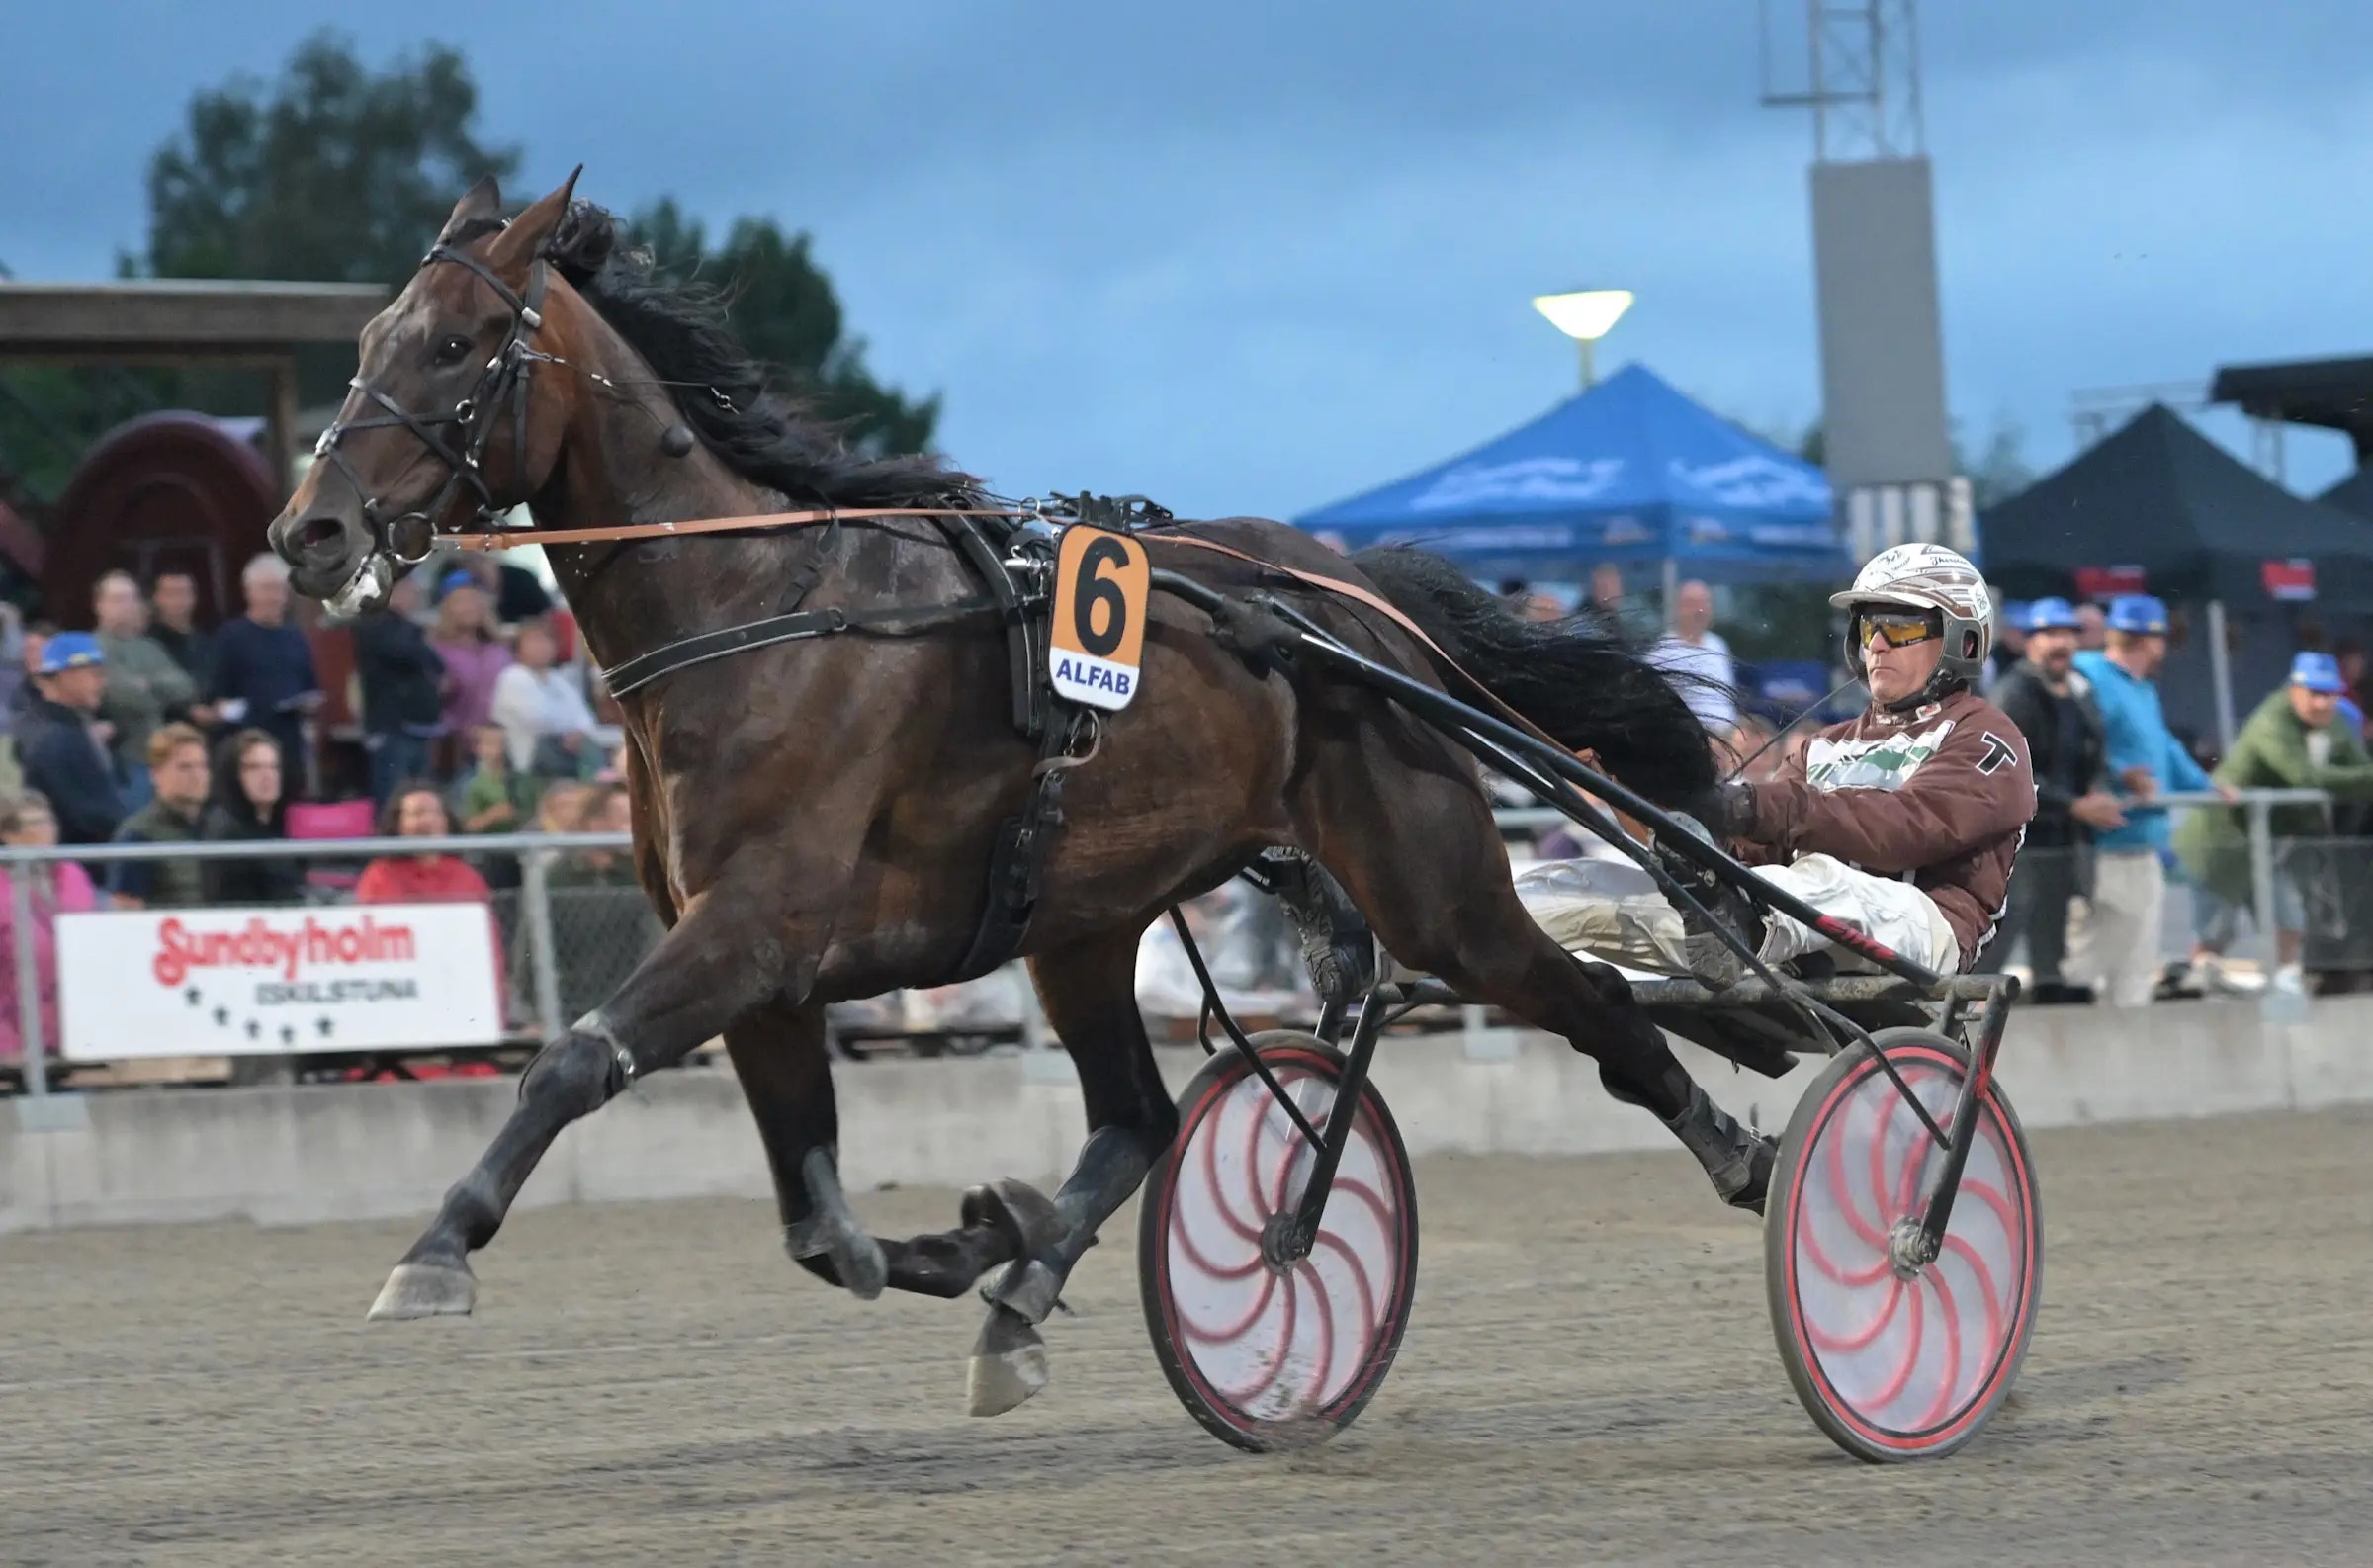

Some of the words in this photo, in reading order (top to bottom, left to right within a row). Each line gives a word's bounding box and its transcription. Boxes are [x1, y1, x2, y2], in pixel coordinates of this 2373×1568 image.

[1074, 536, 1130, 657] 6
[1056, 659, 1130, 695] ALFAB
[1976, 730, 2018, 776] T
[154, 915, 416, 986] Sundbyholm
